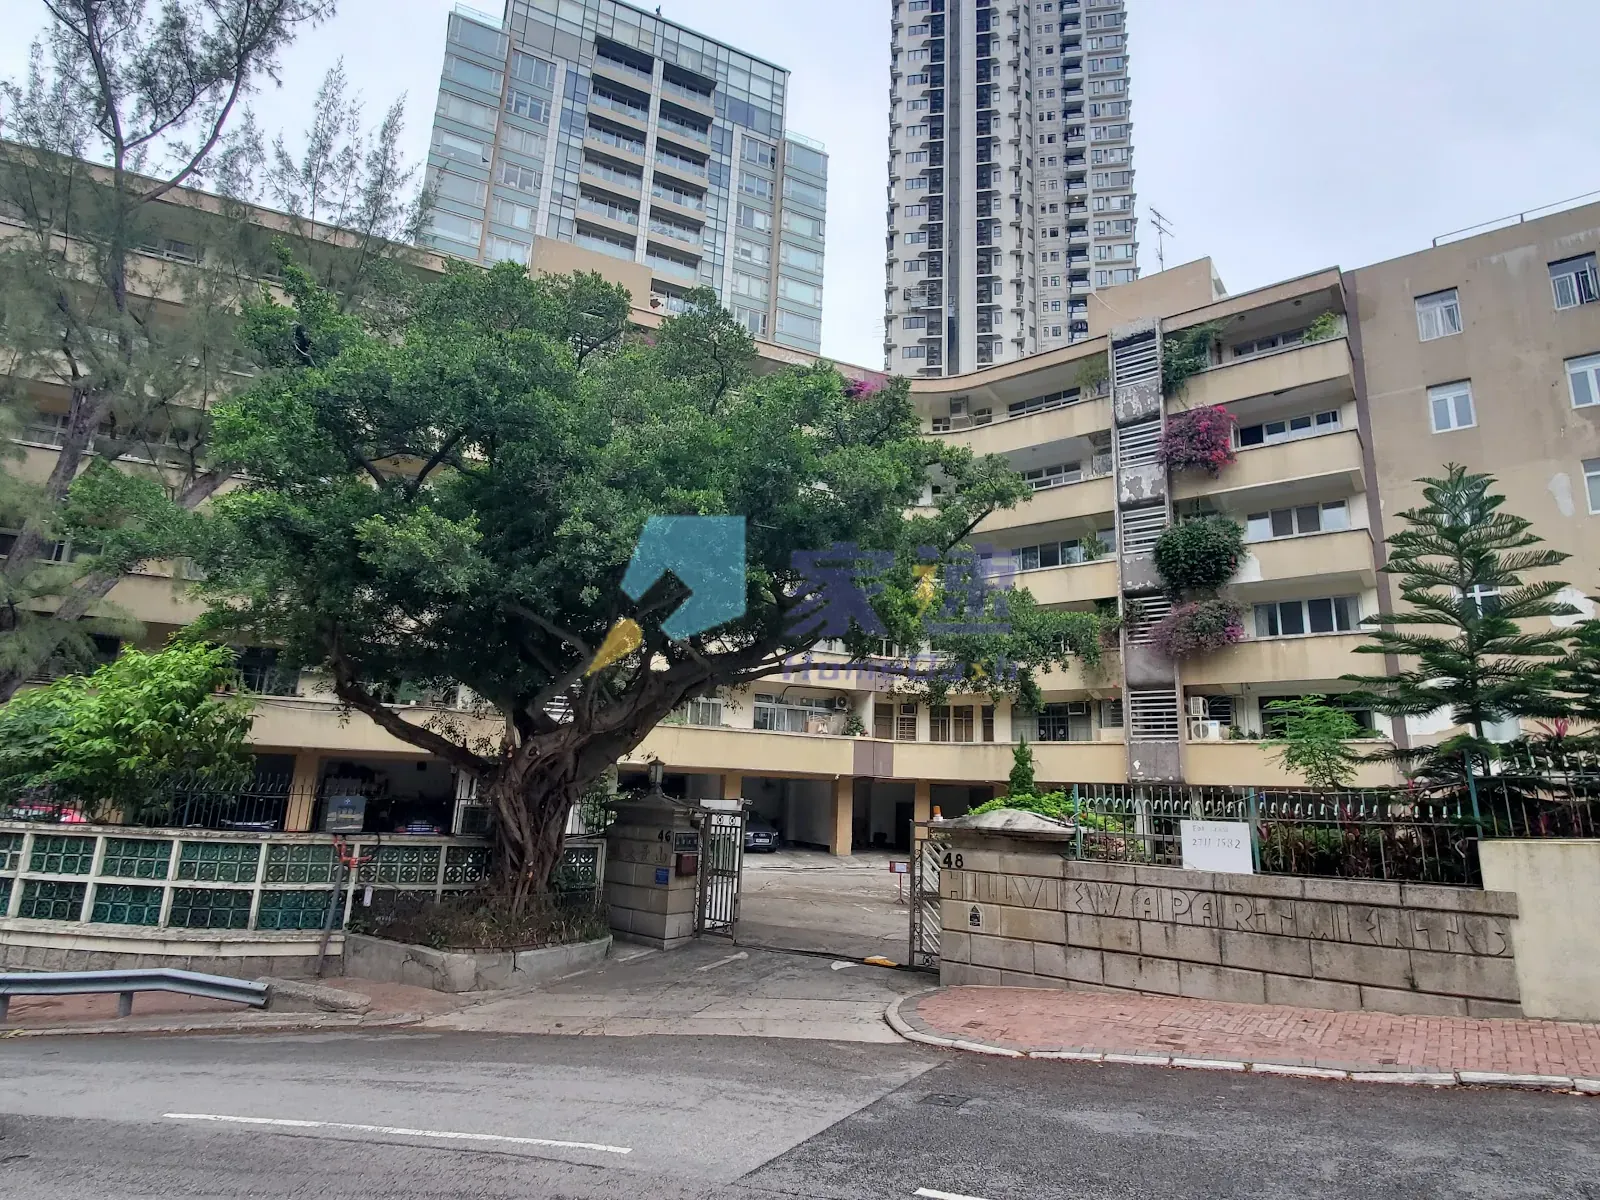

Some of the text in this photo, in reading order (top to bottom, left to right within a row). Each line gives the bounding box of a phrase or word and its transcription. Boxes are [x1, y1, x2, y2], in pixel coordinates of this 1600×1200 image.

[657, 829, 672, 843] 46
[942, 852, 964, 869] 48
[941, 871, 1507, 956] HILLVIEW APARTMENTS
